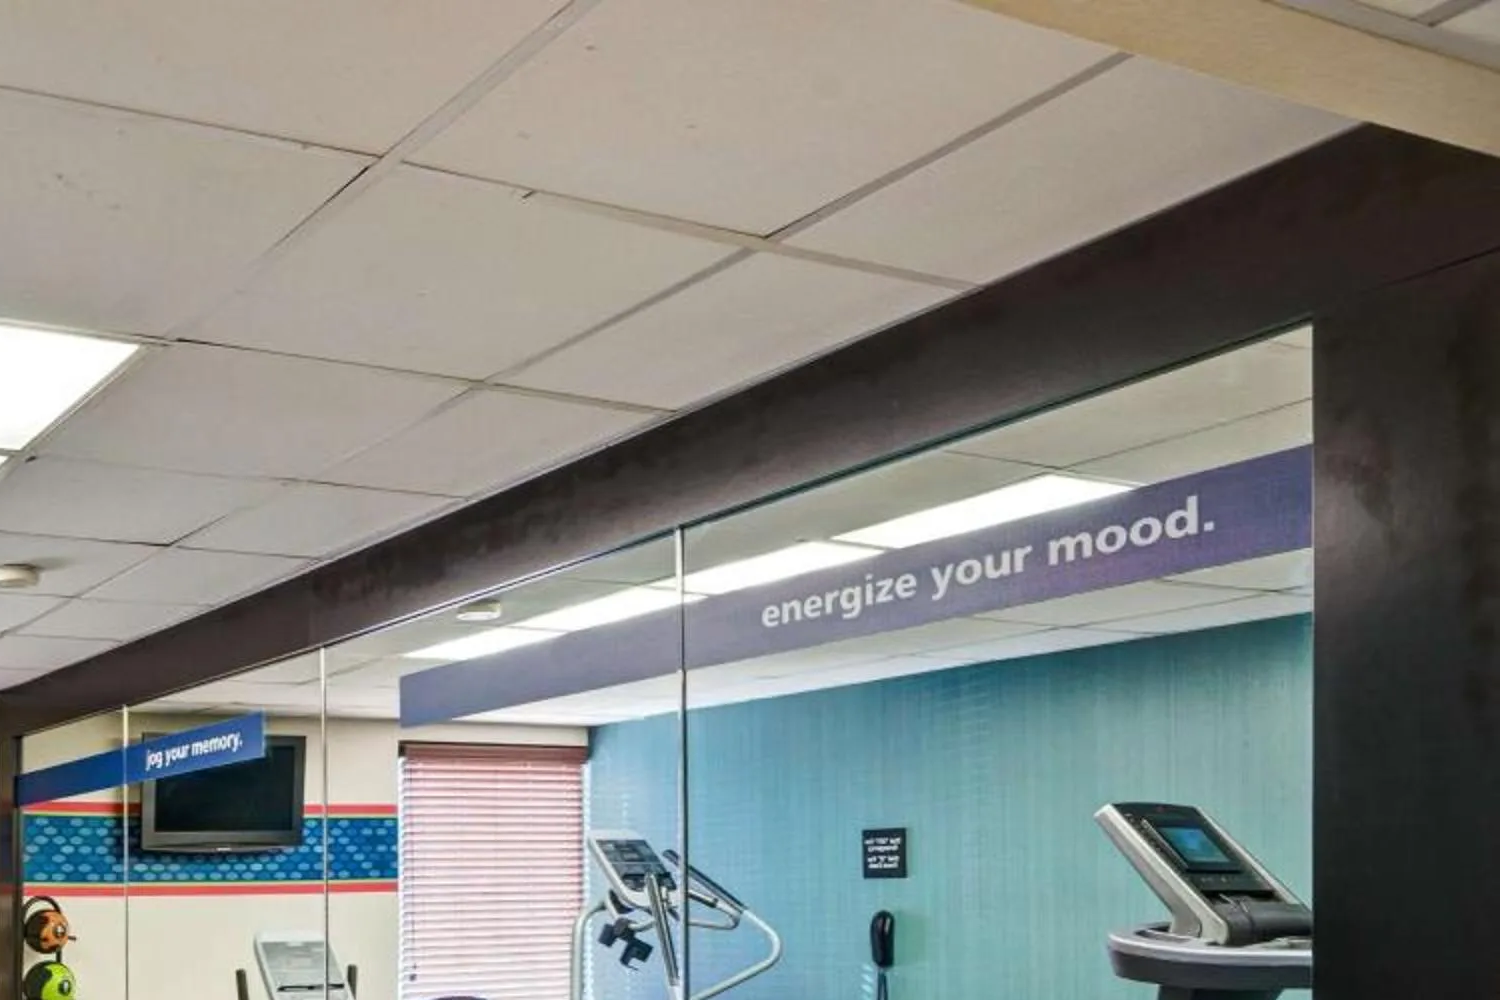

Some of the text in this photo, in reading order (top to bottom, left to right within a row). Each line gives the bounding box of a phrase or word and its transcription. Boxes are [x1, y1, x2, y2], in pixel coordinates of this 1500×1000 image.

[761, 495, 1216, 628] energize your mood.
[145, 731, 244, 773] jog your memory.
